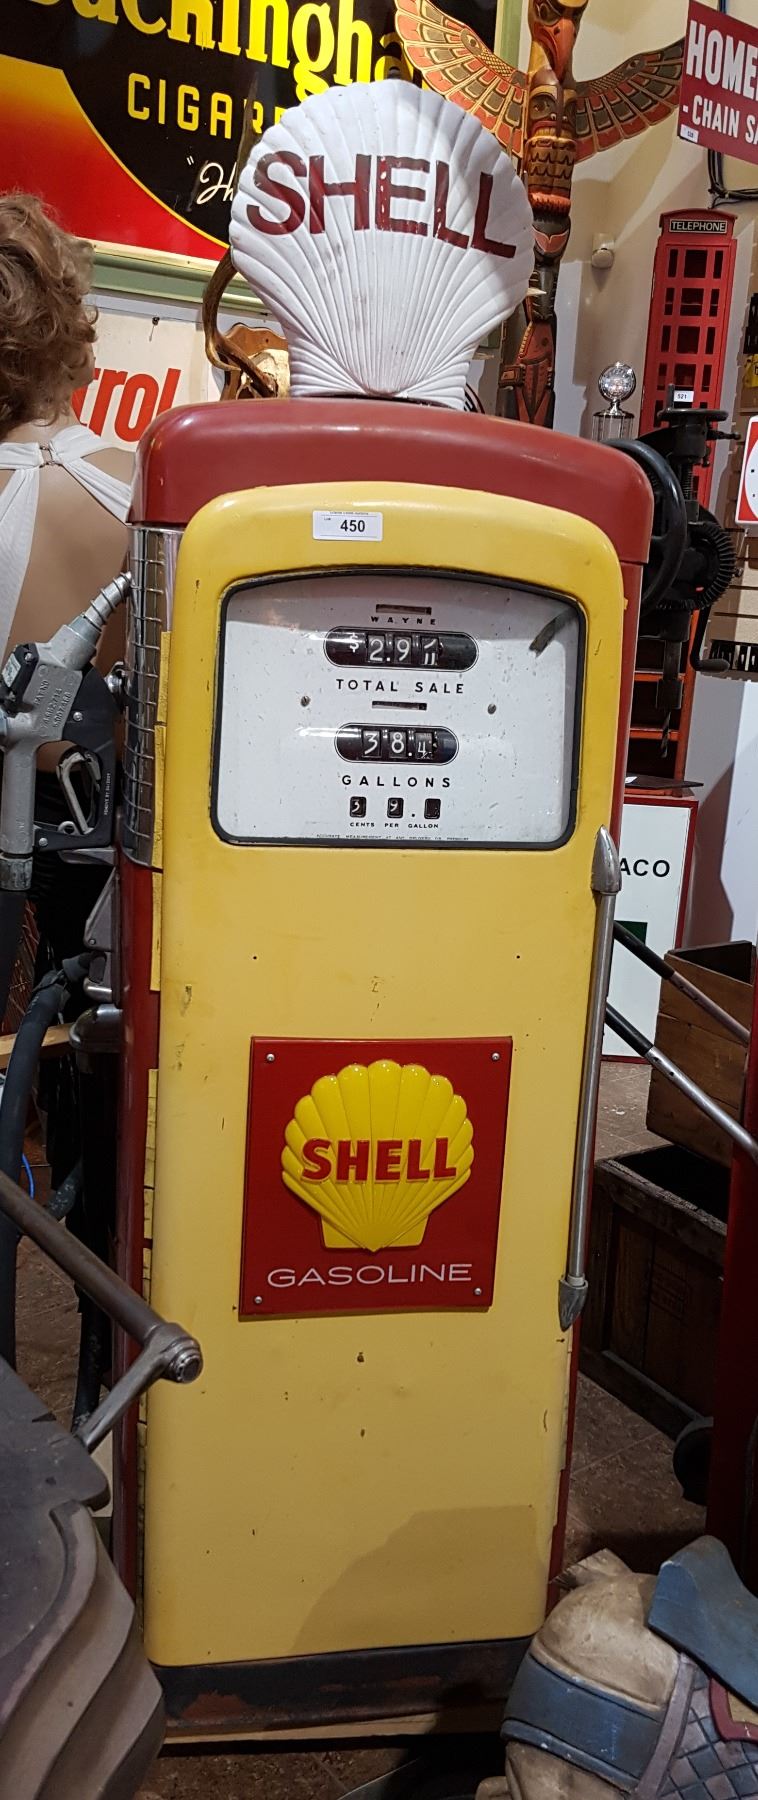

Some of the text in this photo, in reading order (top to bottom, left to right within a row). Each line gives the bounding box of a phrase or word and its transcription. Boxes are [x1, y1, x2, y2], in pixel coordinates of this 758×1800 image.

[686, 20, 758, 101] HOME
[692, 95, 740, 138] CHAIN
[247, 151, 517, 259] SHELL
[671, 221, 726, 232] TELEPHONE
[71, 368, 181, 442] trol
[340, 519, 366, 533] 450
[371, 616, 436, 625] WAYNE
[336, 678, 464, 694] TOTAL SALE
[342, 775, 450, 788] GALLONS
[619, 857, 670, 877] ACO
[301, 1137, 457, 1183] SHELL
[267, 1264, 472, 1288] GASOLINE
